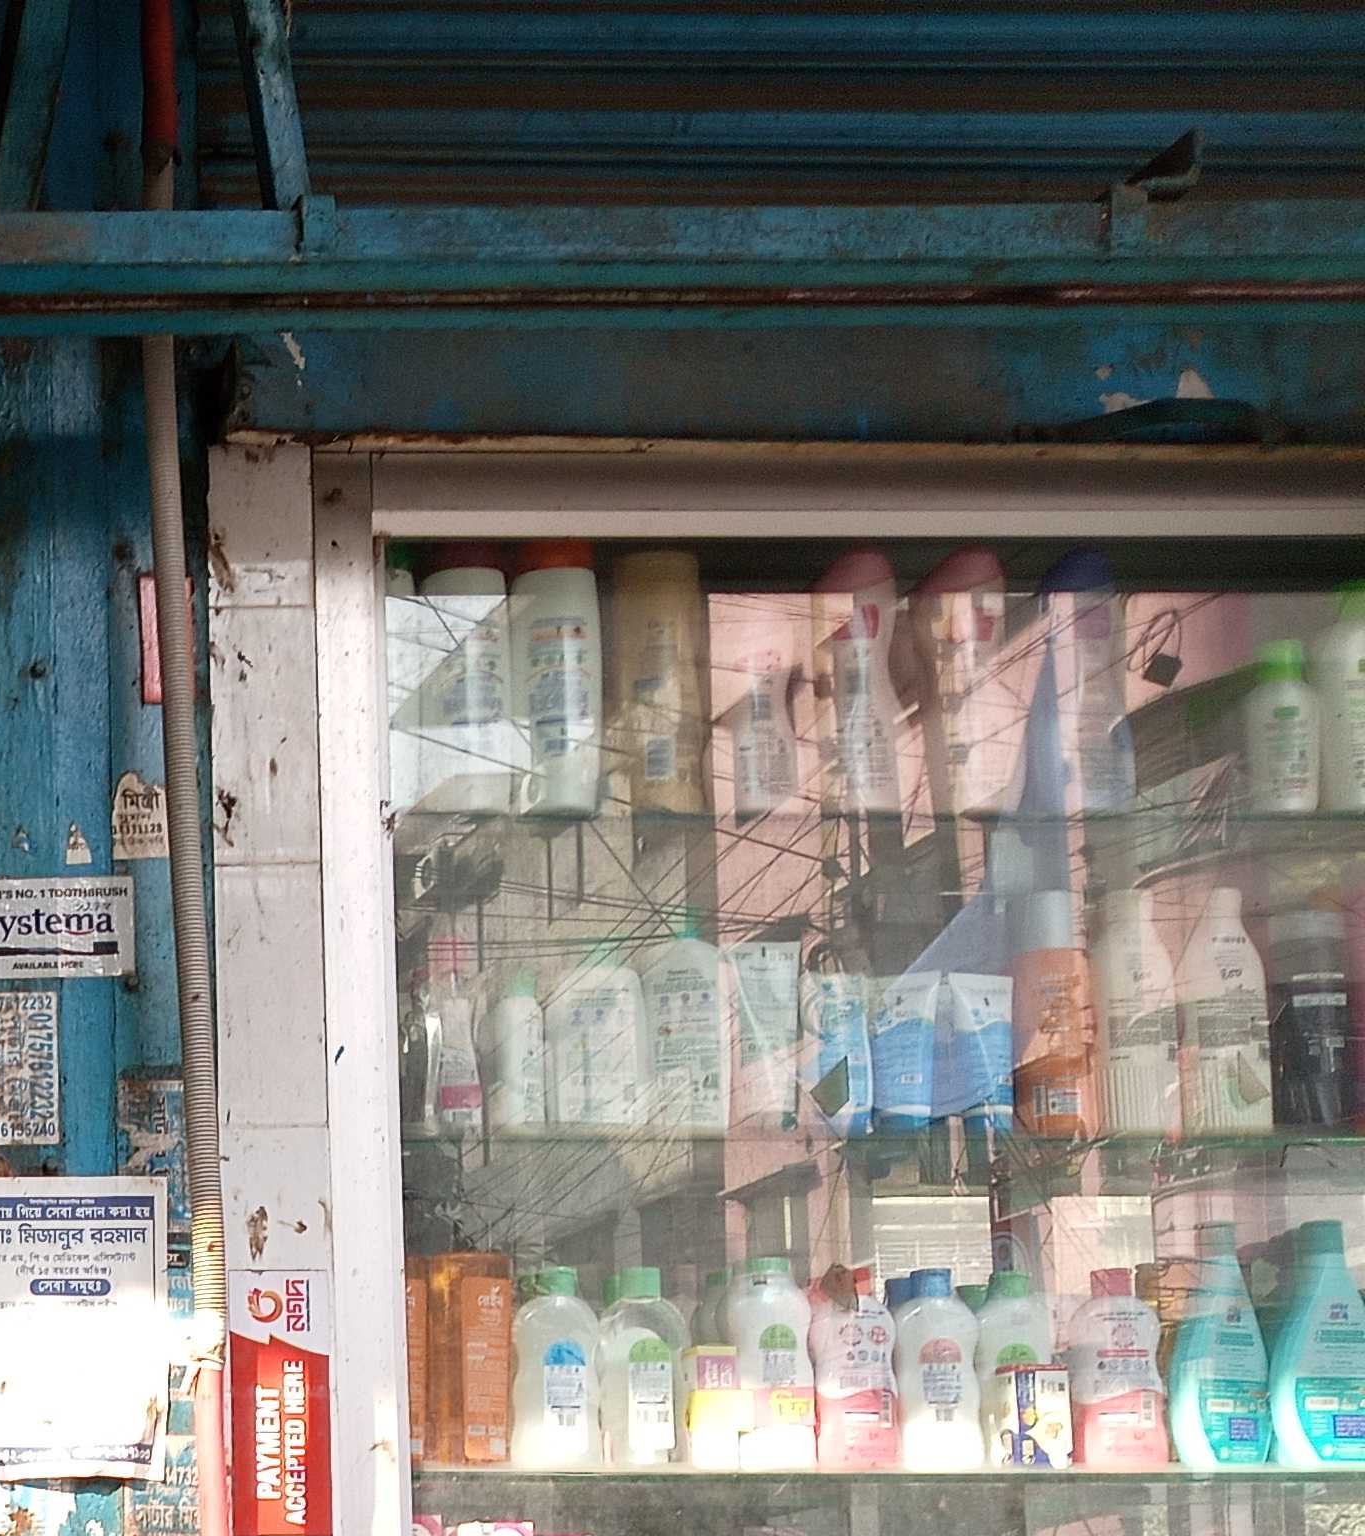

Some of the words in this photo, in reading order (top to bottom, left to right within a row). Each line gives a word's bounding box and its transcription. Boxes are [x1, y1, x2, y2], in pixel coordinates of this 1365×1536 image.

[48, 886, 128, 898] TOOTHBRUSH
[12, 961, 59, 971] AVAILABLE
[46, 1205, 72, 1219] সেবা
[75, 1205, 106, 1219] প্রদান
[109, 1205, 131, 1218] করা
[18, 1223, 84, 1250] মিজানুর
[90, 1227, 147, 1245] রহমান
[38, 1279, 65, 1293] সেবা
[285, 1278, 306, 1333] নগদ
[283, 1359, 306, 1415] HERE
[256, 1384, 282, 1500] PAYMENT
[284, 1415, 307, 1525] ACCEPTED
